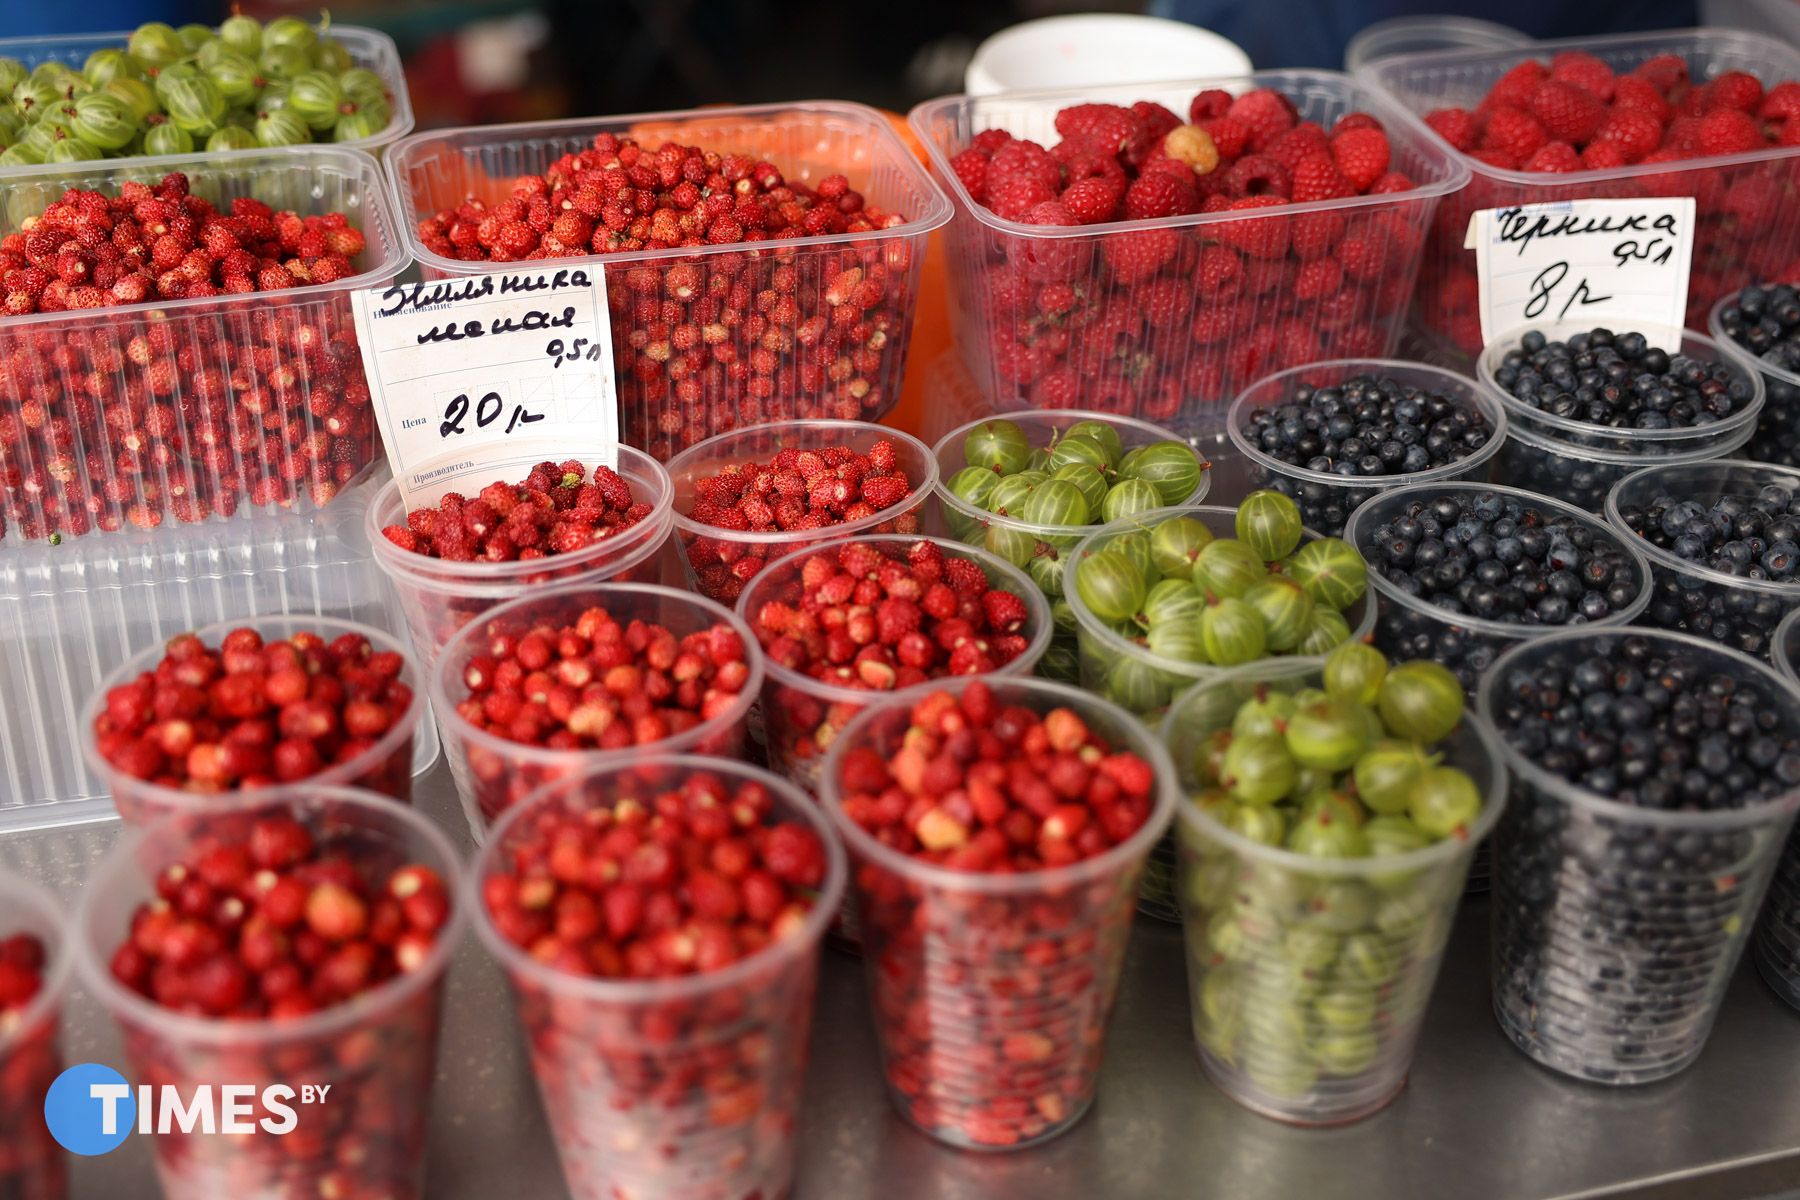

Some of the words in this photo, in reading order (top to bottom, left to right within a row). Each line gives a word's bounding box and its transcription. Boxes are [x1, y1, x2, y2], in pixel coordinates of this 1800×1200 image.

[1498, 206, 1677, 256] Черника
[381, 269, 592, 316] Земляника
[546, 338, 602, 369] 0,5л
[402, 416, 427, 430] Цена
[413, 460, 475, 484] Производитель
